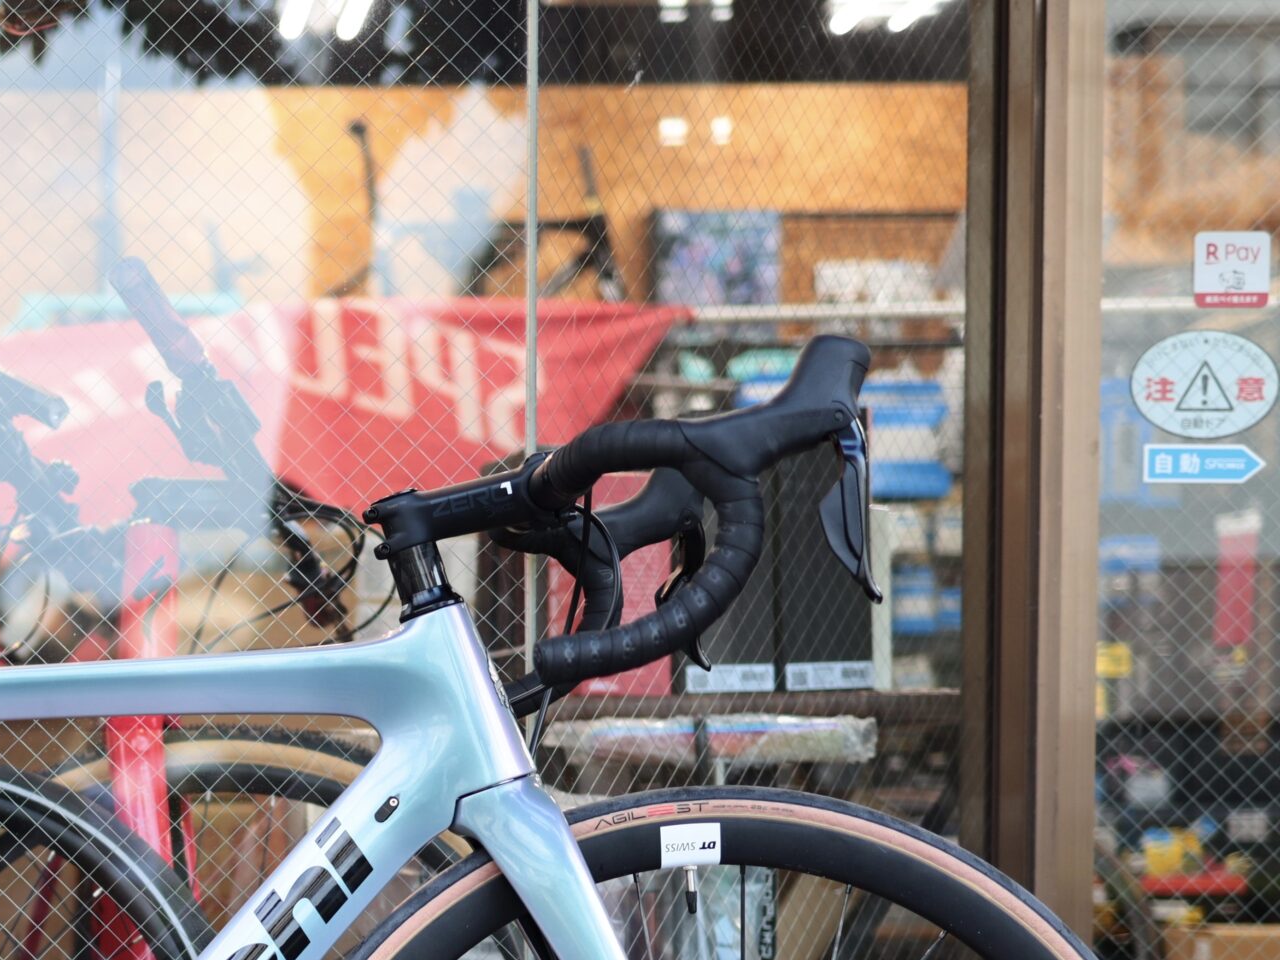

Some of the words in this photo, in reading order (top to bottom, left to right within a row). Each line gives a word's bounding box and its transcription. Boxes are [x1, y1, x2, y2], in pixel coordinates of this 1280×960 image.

[1205, 243, 1219, 261] R
[1224, 243, 1261, 264] Pay
[1146, 377, 1175, 402] 注
[1236, 377, 1265, 402] 意
[1154, 453, 1201, 474] 自動
[664, 841, 696, 853] SWISS
[698, 840, 717, 850] DT
